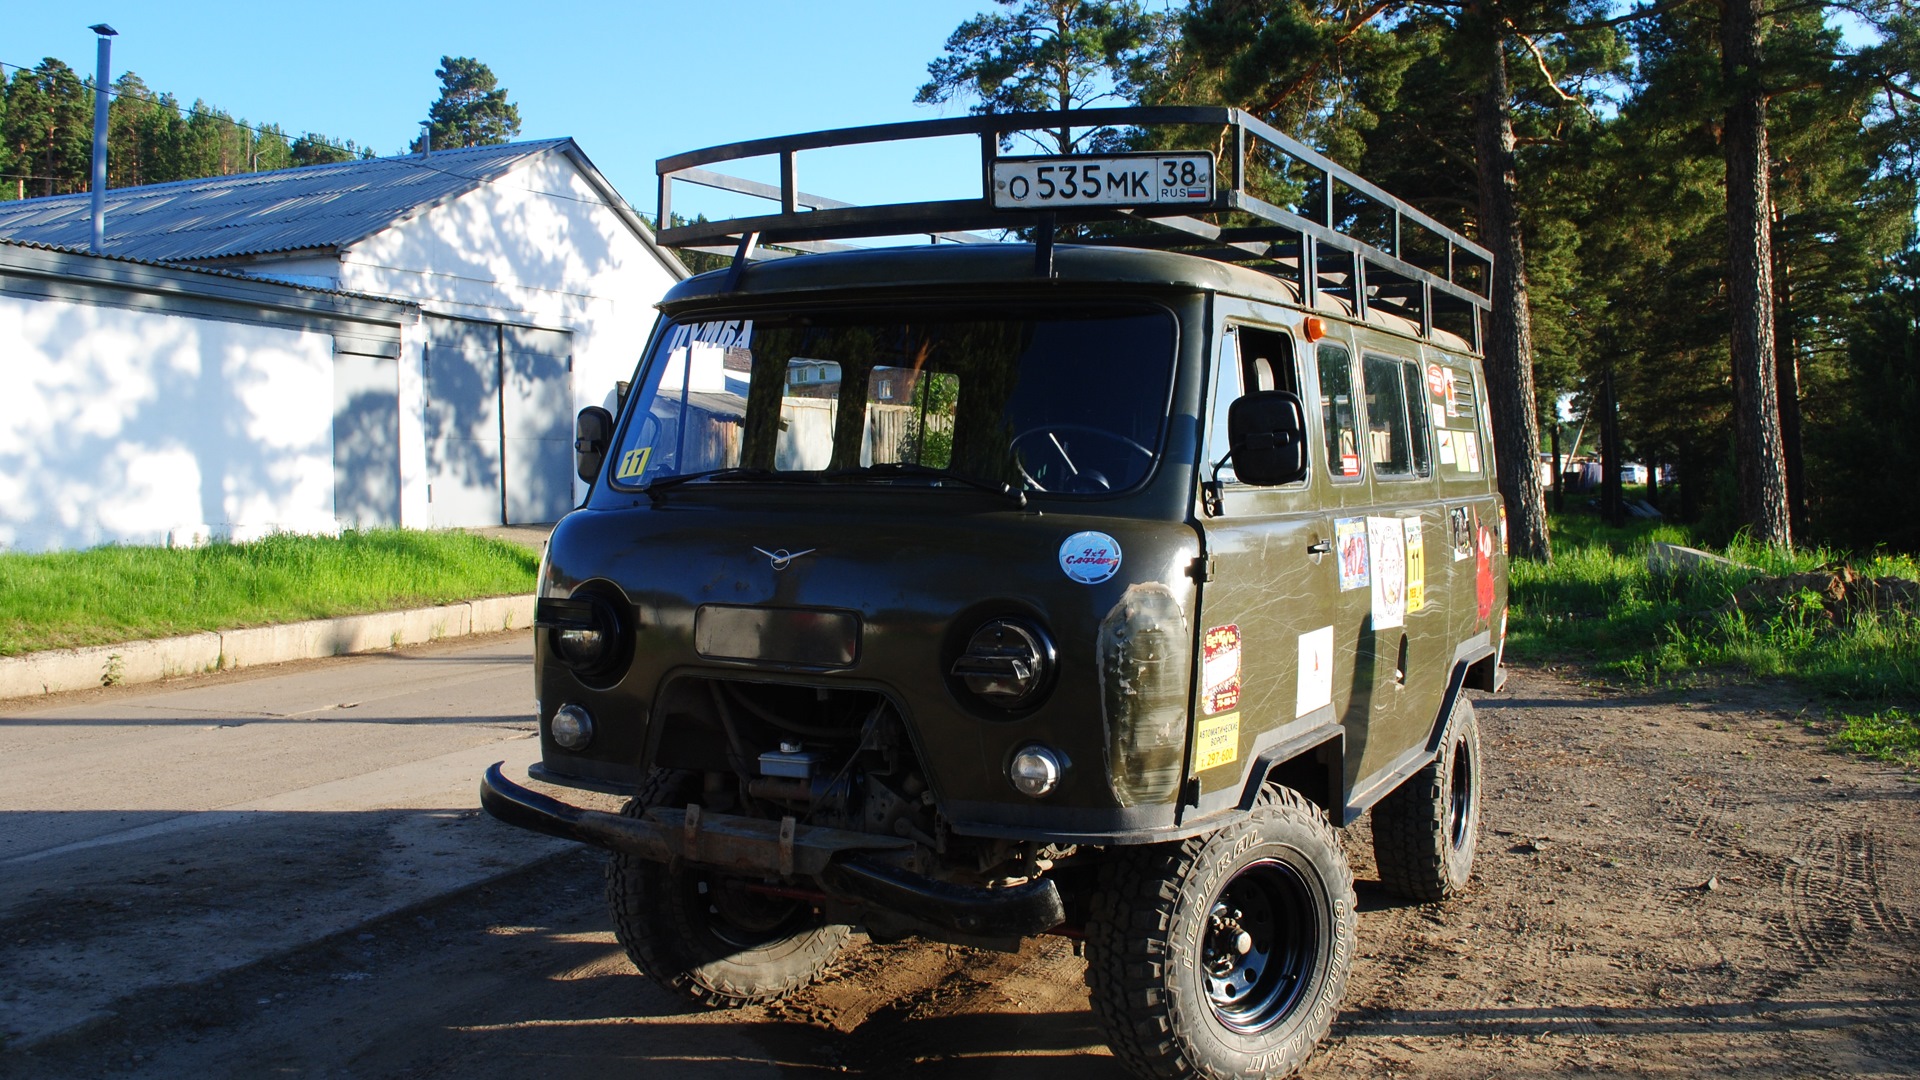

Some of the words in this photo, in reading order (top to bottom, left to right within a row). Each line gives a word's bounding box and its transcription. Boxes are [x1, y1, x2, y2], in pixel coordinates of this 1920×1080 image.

[1162, 160, 1197, 187] 38
[1161, 187, 1187, 198] RUS
[667, 319, 753, 354] ПУМБА
[624, 450, 646, 475] 11
[1210, 735, 1228, 747] ВОРОТА
[1183, 829, 1264, 969] FEDERAL
[1293, 899, 1346, 1054] COURAGIA
